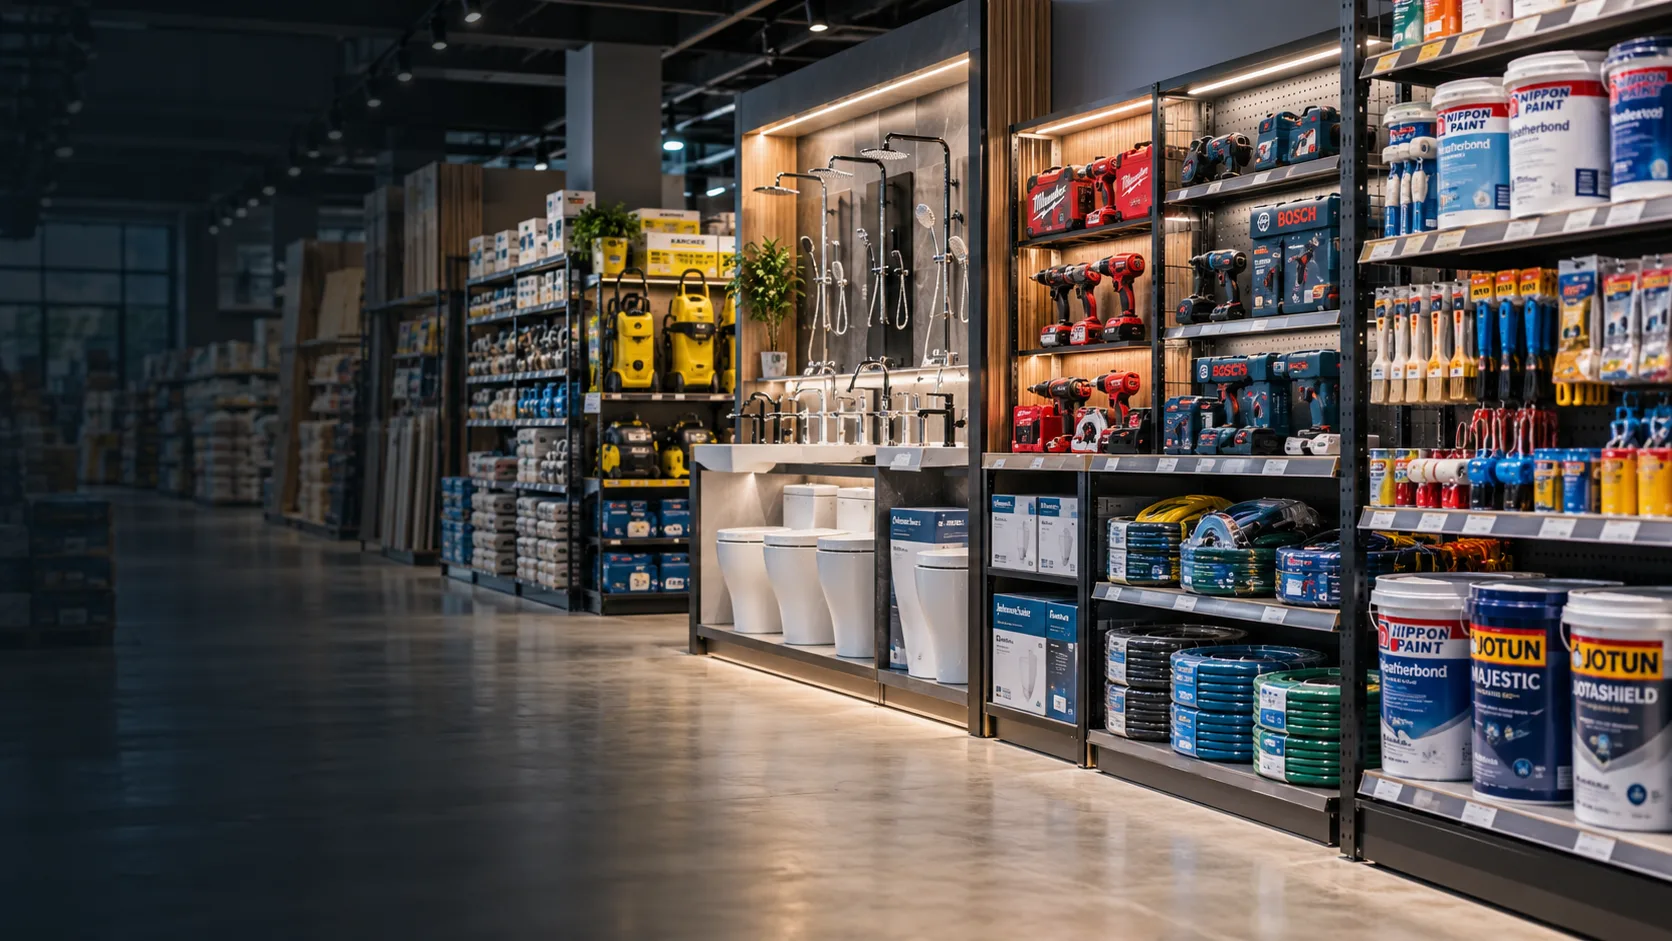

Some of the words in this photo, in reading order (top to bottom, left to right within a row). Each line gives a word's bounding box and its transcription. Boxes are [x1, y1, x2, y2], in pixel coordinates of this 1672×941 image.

[1520, 87, 1570, 103] NIPPON
[1525, 99, 1564, 114] PAINT
[1447, 109, 1491, 123] NIPPON
[1451, 119, 1486, 133] PAINT
[1277, 206, 1317, 227] BOSCH
[1397, 639, 1444, 655] PAINT
[1478, 636, 1541, 661] JOTUN
[1584, 648, 1659, 674] JOTUN
